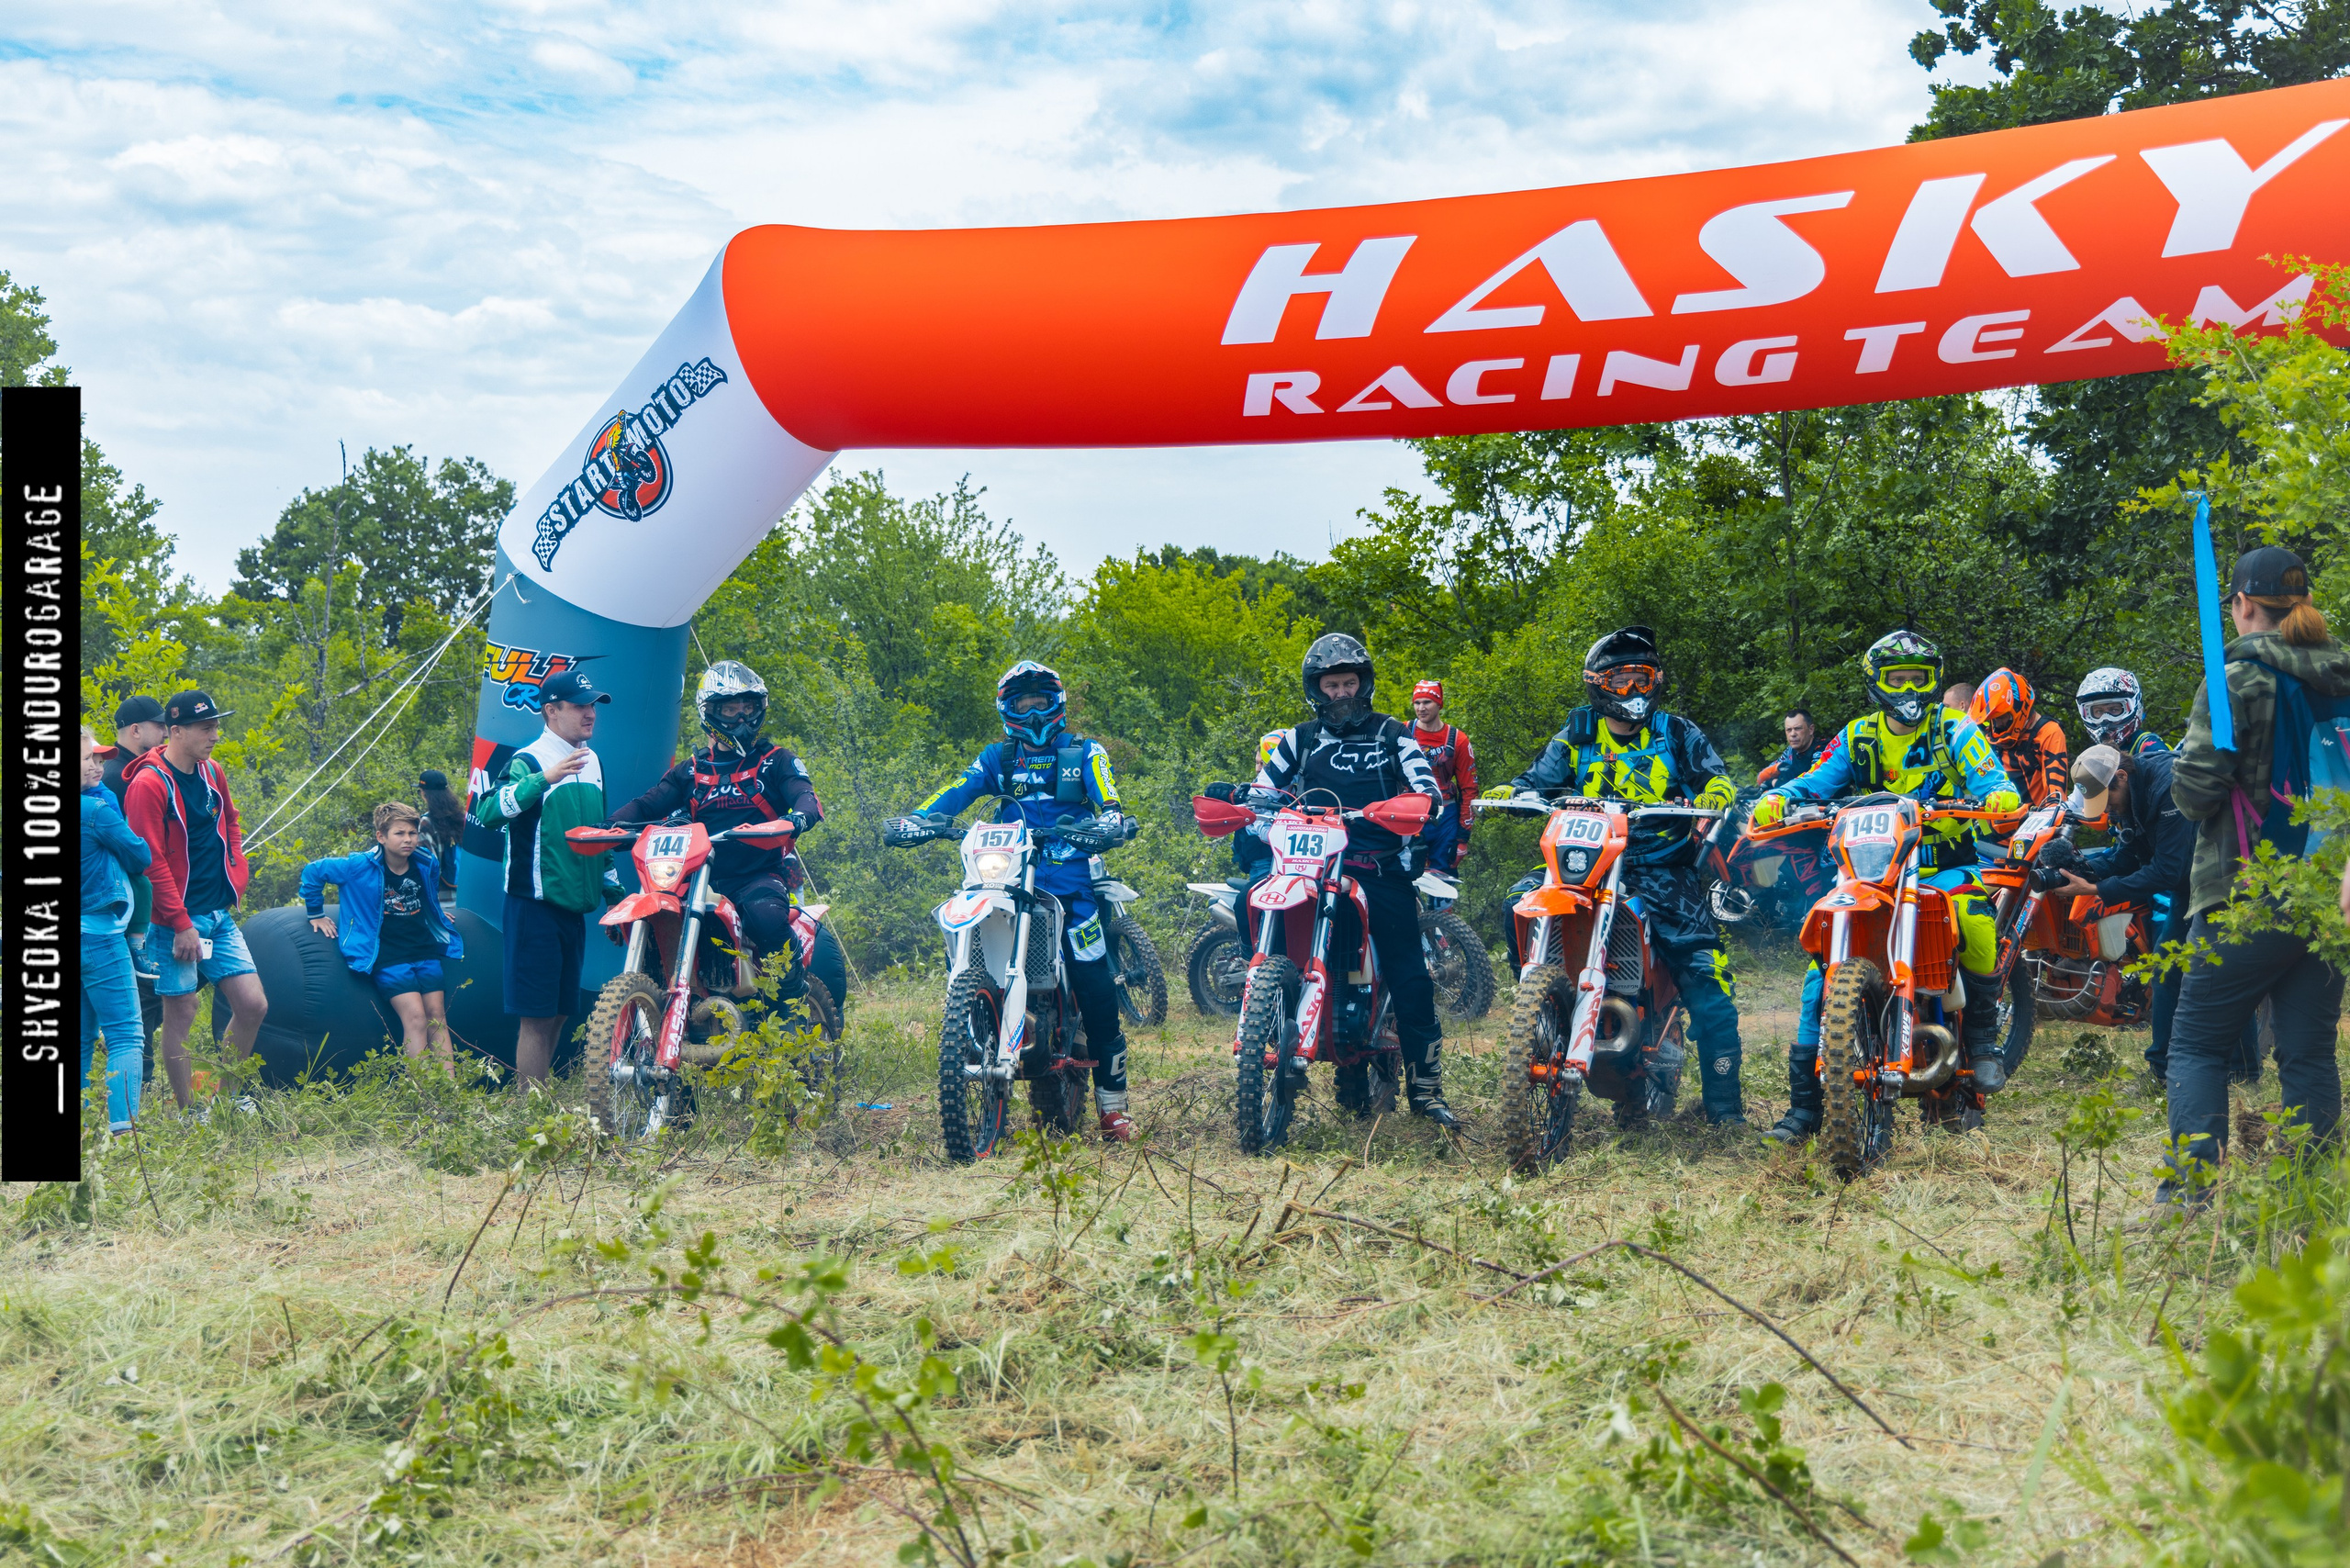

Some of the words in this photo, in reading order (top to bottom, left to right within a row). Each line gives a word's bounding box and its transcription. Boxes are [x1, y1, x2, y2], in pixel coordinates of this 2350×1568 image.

[1221, 118, 2350, 345] HASKY
[1243, 335, 1797, 416] RACING
[1844, 273, 2317, 375] TEAM
[2010, 681, 2020, 700] HJC
[1565, 818, 1603, 841] 150
[1851, 812, 1890, 837] 149
[653, 835, 684, 856] 144
[980, 830, 1013, 847] 157
[1288, 834, 1323, 857] 143
[1902, 1012, 1911, 1058] KEWS
